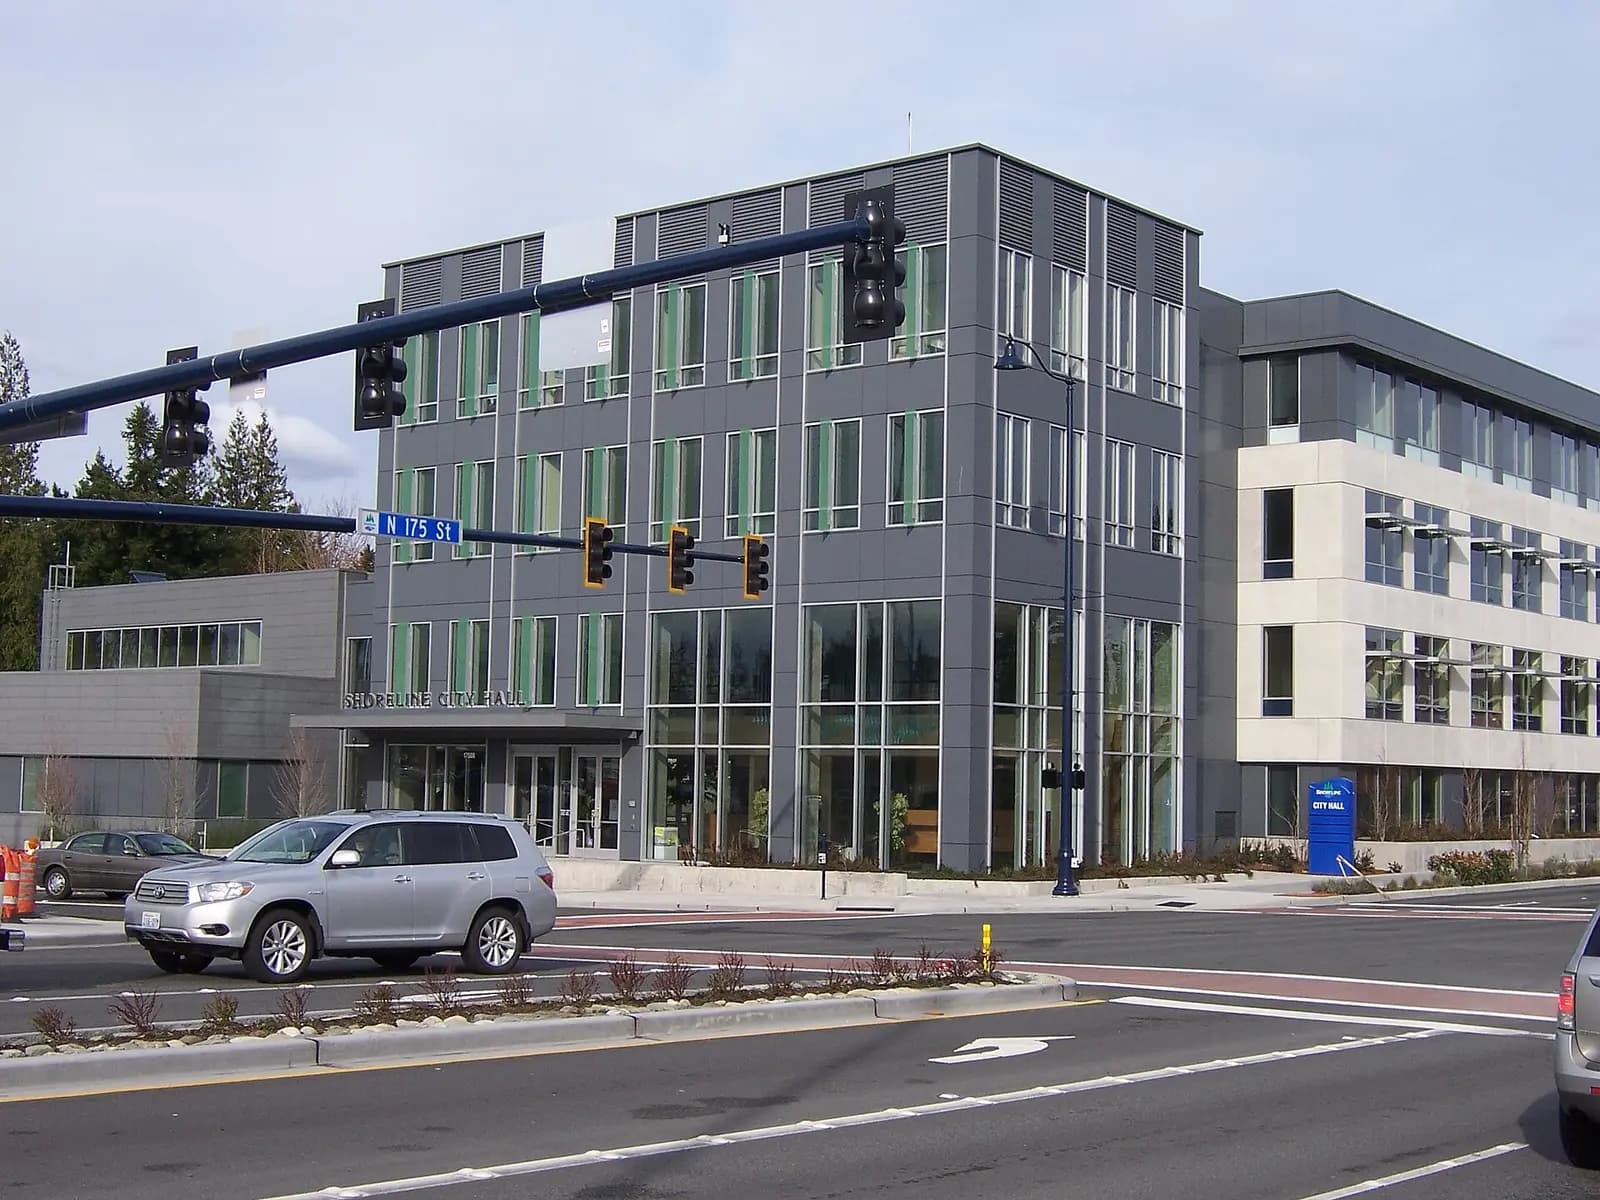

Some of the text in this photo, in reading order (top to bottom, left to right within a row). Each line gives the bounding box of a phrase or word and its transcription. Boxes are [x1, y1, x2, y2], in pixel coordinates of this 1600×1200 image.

[387, 515, 451, 541] N 175 St
[343, 691, 525, 709] SHORELINE CITY HALL
[1312, 801, 1345, 810] CITY HALL
